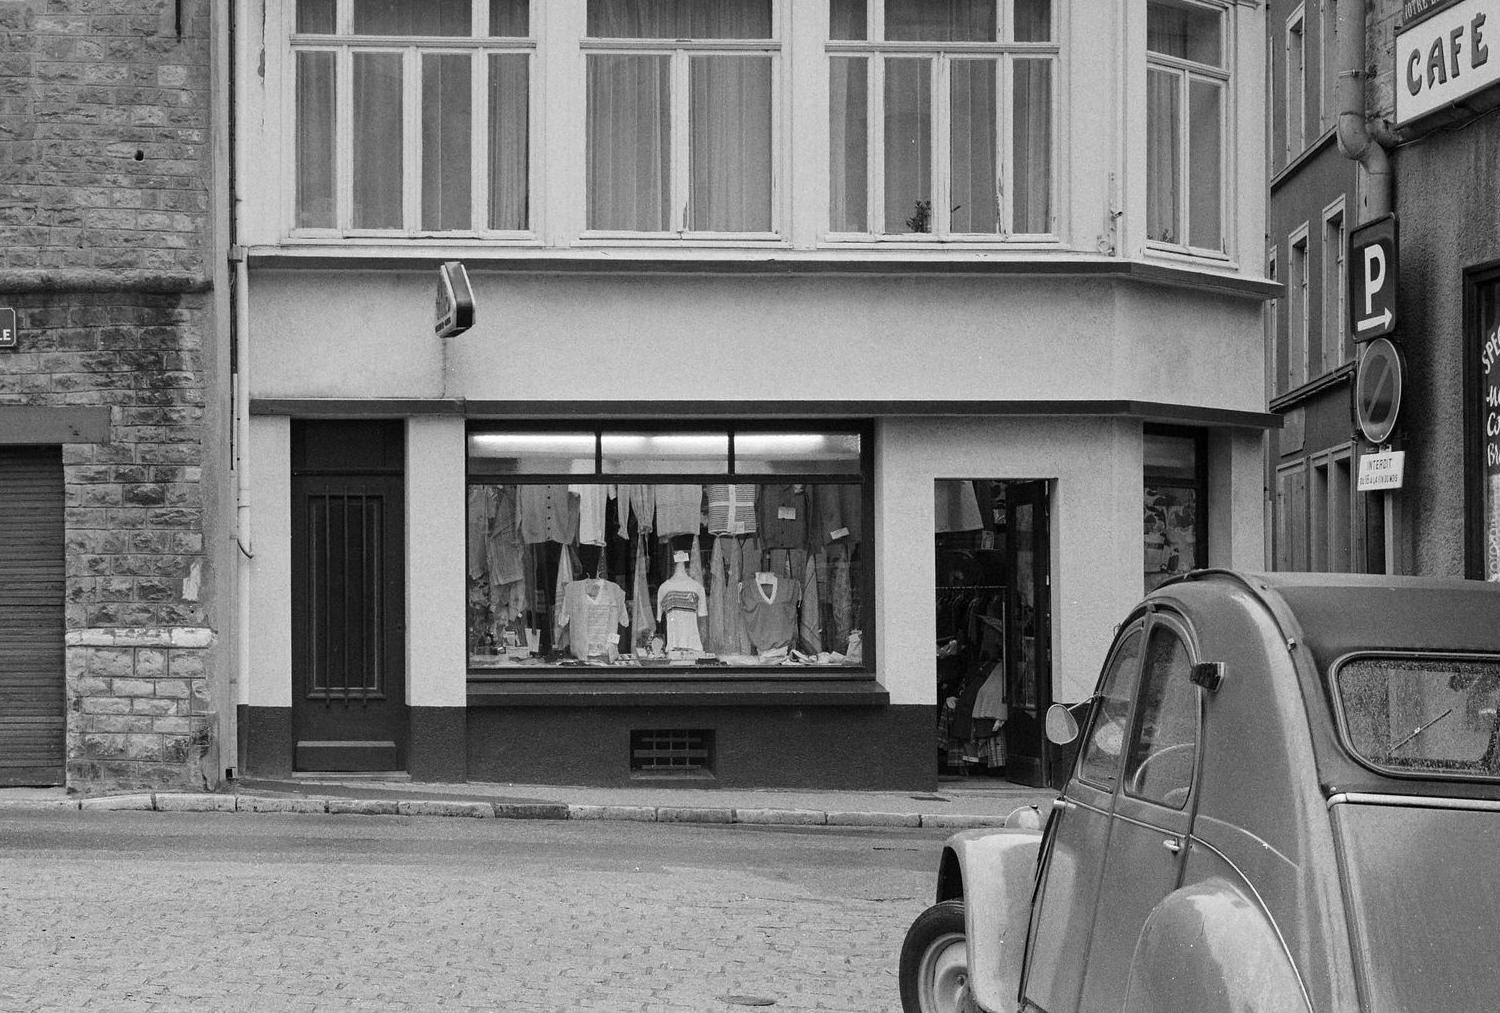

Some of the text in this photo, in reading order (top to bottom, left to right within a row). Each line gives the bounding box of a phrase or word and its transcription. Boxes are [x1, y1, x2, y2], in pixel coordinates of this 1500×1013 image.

[1407, 12, 1488, 96] CAFÉ
[1364, 243, 1386, 315] P
[1482, 325, 1500, 375] SPE
[1367, 458, 1393, 471] INTERDIT
